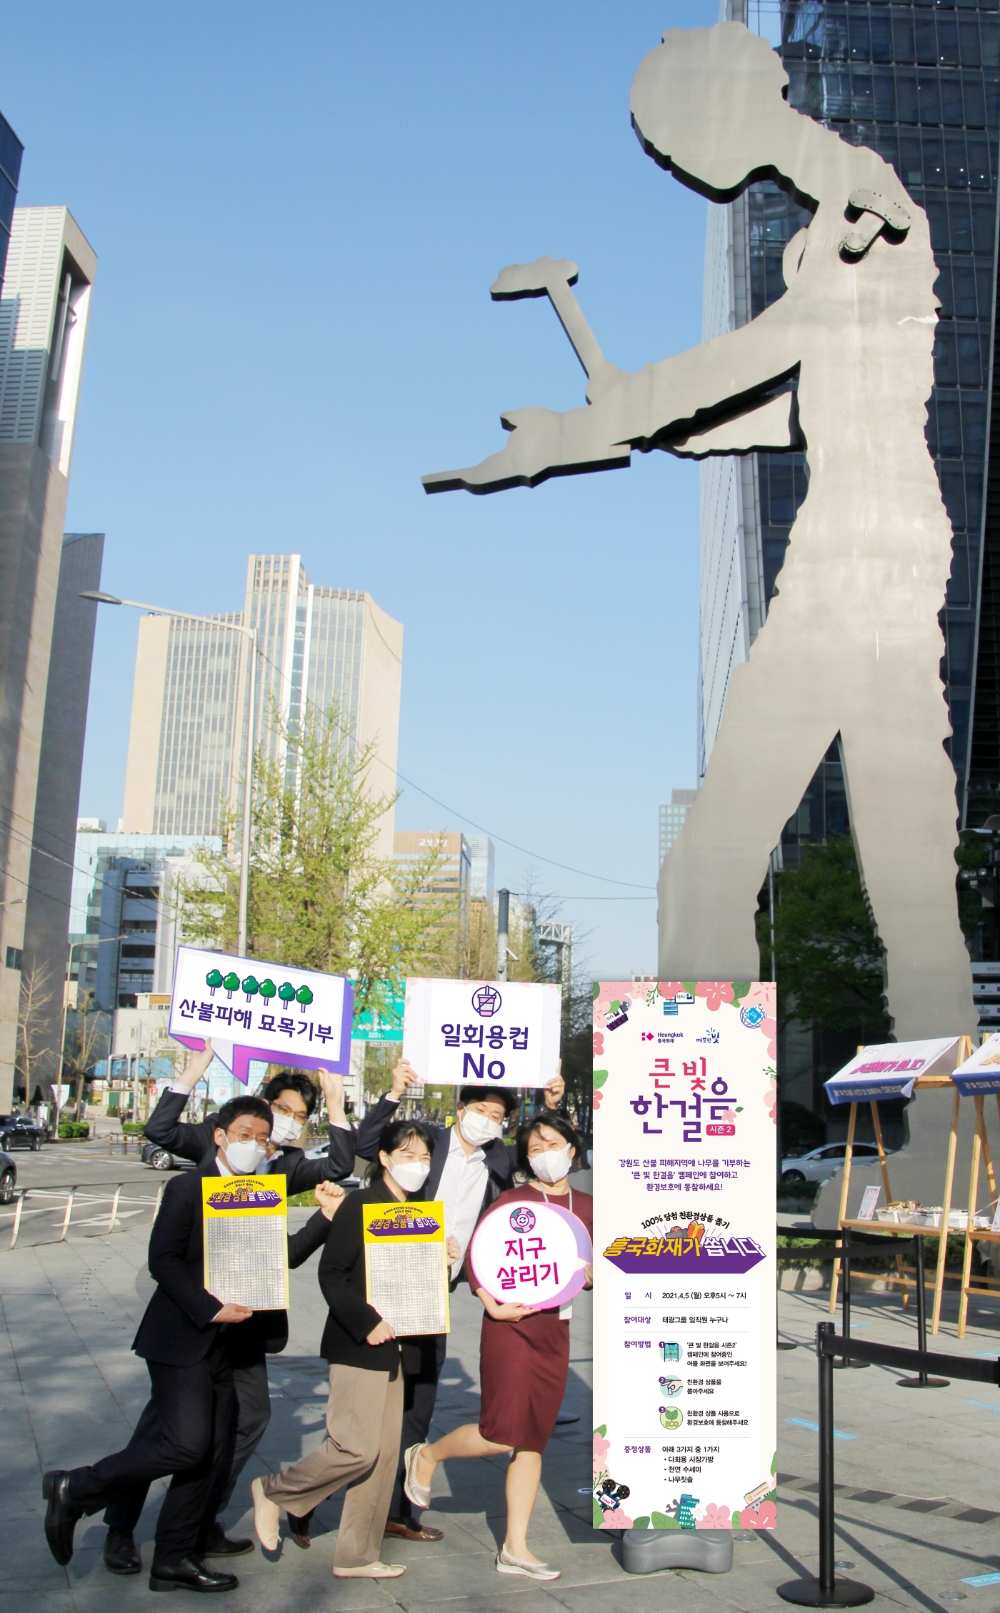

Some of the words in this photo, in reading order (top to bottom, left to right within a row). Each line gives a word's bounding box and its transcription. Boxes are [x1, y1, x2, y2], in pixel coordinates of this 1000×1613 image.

[178, 998, 252, 1029] 산불피해
[258, 1014, 334, 1044] 묘목기부
[441, 1023, 529, 1050] 일회용컵
[463, 1053, 505, 1080] No
[649, 1058, 675, 1088] 큰
[682, 1056, 707, 1091] 빛
[630, 1077, 737, 1142] 한걸음
[709, 1125, 725, 1134] 시즌
[726, 1125, 732, 1134] 2
[618, 1158, 640, 1168] 강원도
[642, 1158, 657, 1168] 산불
[659, 1158, 695, 1168] 피해지역에
[698, 1158, 719, 1168] 나무를
[722, 1158, 751, 1168] 기부하는
[643, 1170, 651, 1180] 빛
[678, 1170, 707, 1180] 캠페인에
[709, 1170, 738, 1180] 참여하고
[646, 1182, 682, 1192] 환경보호에
[684, 1182, 723, 1192] 동참하세요!
[641, 1215, 663, 1229] 100%
[664, 1212, 678, 1221] 당첨
[505, 1237, 546, 1260] 지구
[603, 1236, 701, 1257] 흥국화재가
[701, 1236, 766, 1257] 쏩니다
[497, 1262, 559, 1290] 살리기
[662, 1292, 690, 1300] 2021.4.5
[691, 1291, 702, 1300] (월)
[703, 1291, 726, 1300] 오후5시
[736, 1291, 747, 1300] 7시
[624, 1316, 652, 1325] 참여대상
[662, 1315, 687, 1324] 태광그룹
[689, 1315, 708, 1324] 임직원
[709, 1315, 729, 1324] 누구나
[624, 1340, 652, 1349] 참여방법
[696, 1341, 702, 1349] 빛
[687, 1378, 704, 1386] 친환경
[624, 1445, 652, 1454] 증정상품
[662, 1445, 675, 1454] 아래
[677, 1445, 693, 1454] 3가지
[695, 1445, 702, 1454] 중
[704, 1445, 720, 1454] 1가지
[668, 1455, 687, 1464] 다회용
[689, 1455, 714, 1464] 시장가방
[668, 1465, 682, 1474] 천연
[683, 1465, 702, 1474] 수세미
[668, 1475, 693, 1484] 나무칫솔
